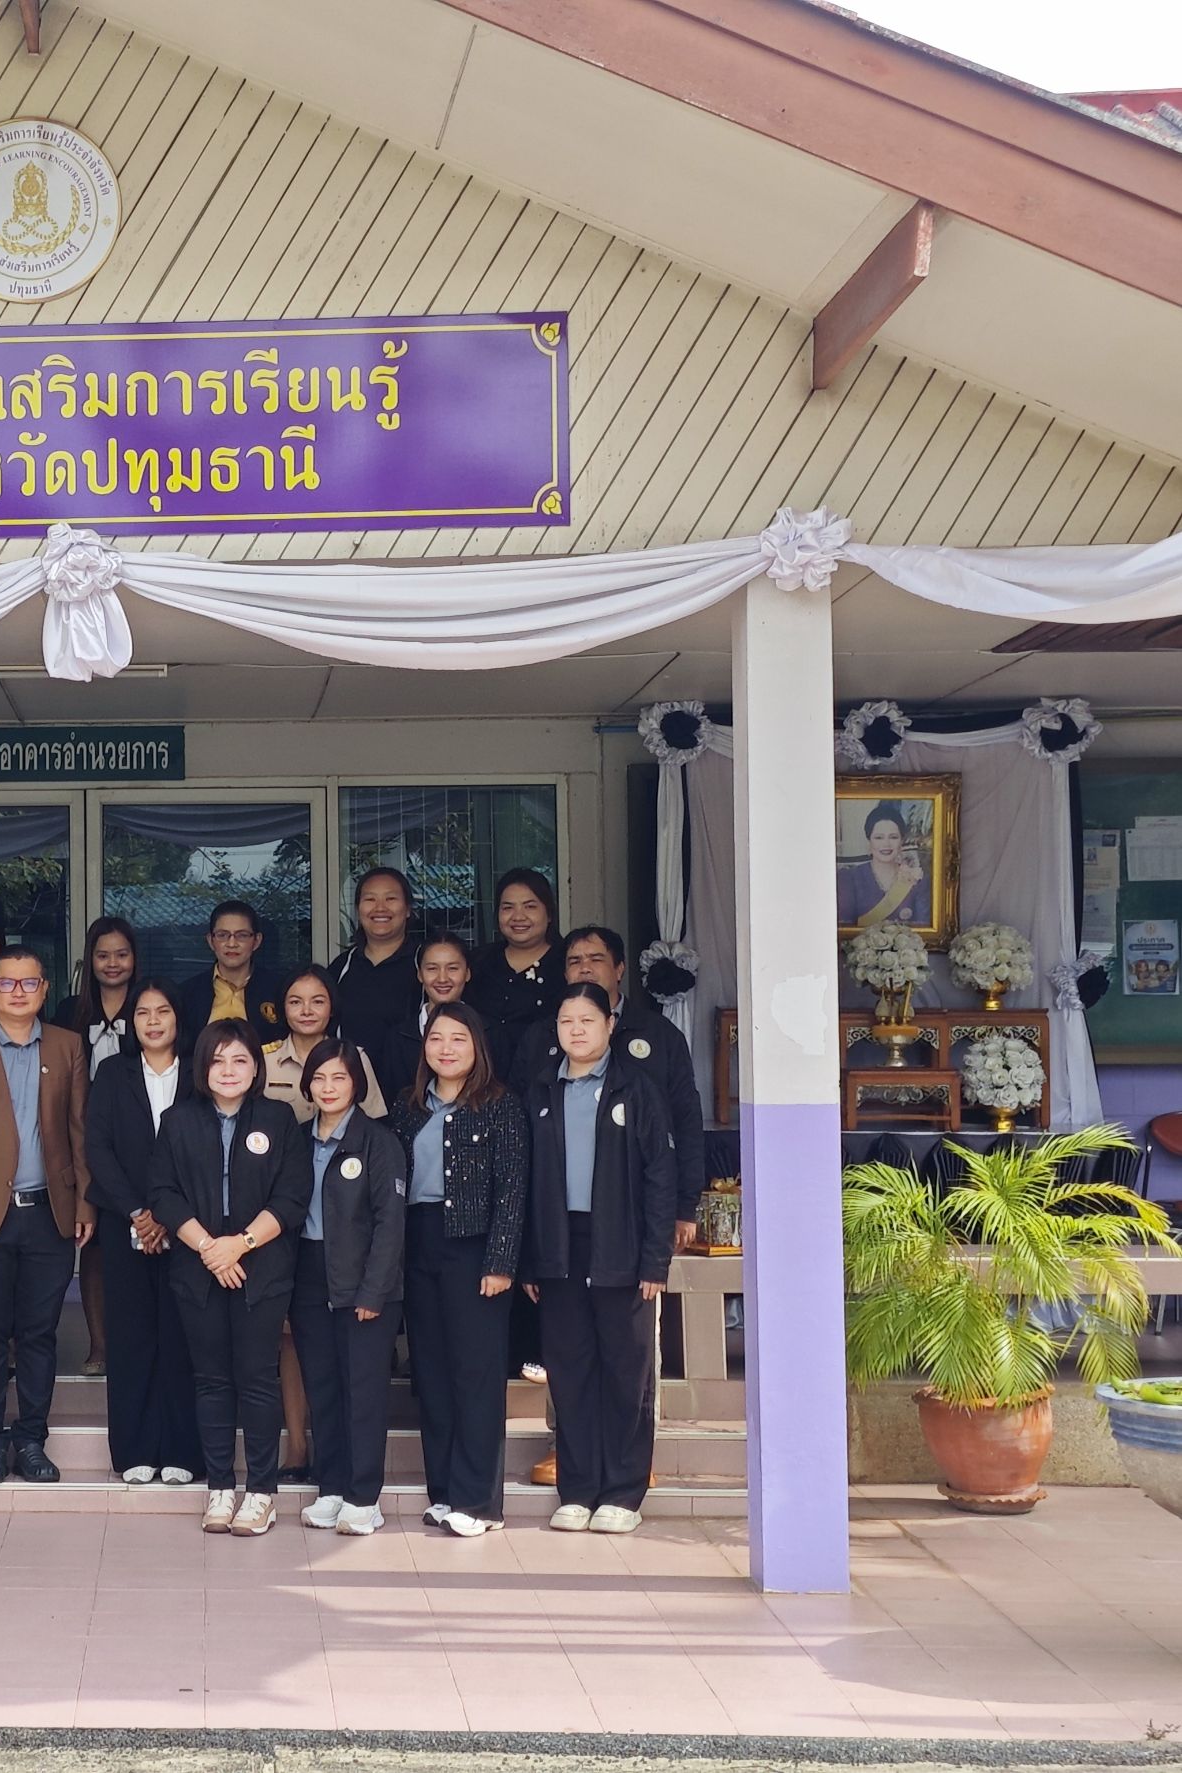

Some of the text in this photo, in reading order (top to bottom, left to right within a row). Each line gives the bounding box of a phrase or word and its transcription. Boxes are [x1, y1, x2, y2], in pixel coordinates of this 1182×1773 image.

[2, 150, 47, 164] LEARNING
[48, 153, 92, 218] ENCOURAGEMENT
[9, 279, 52, 298] ปทุมธานี
